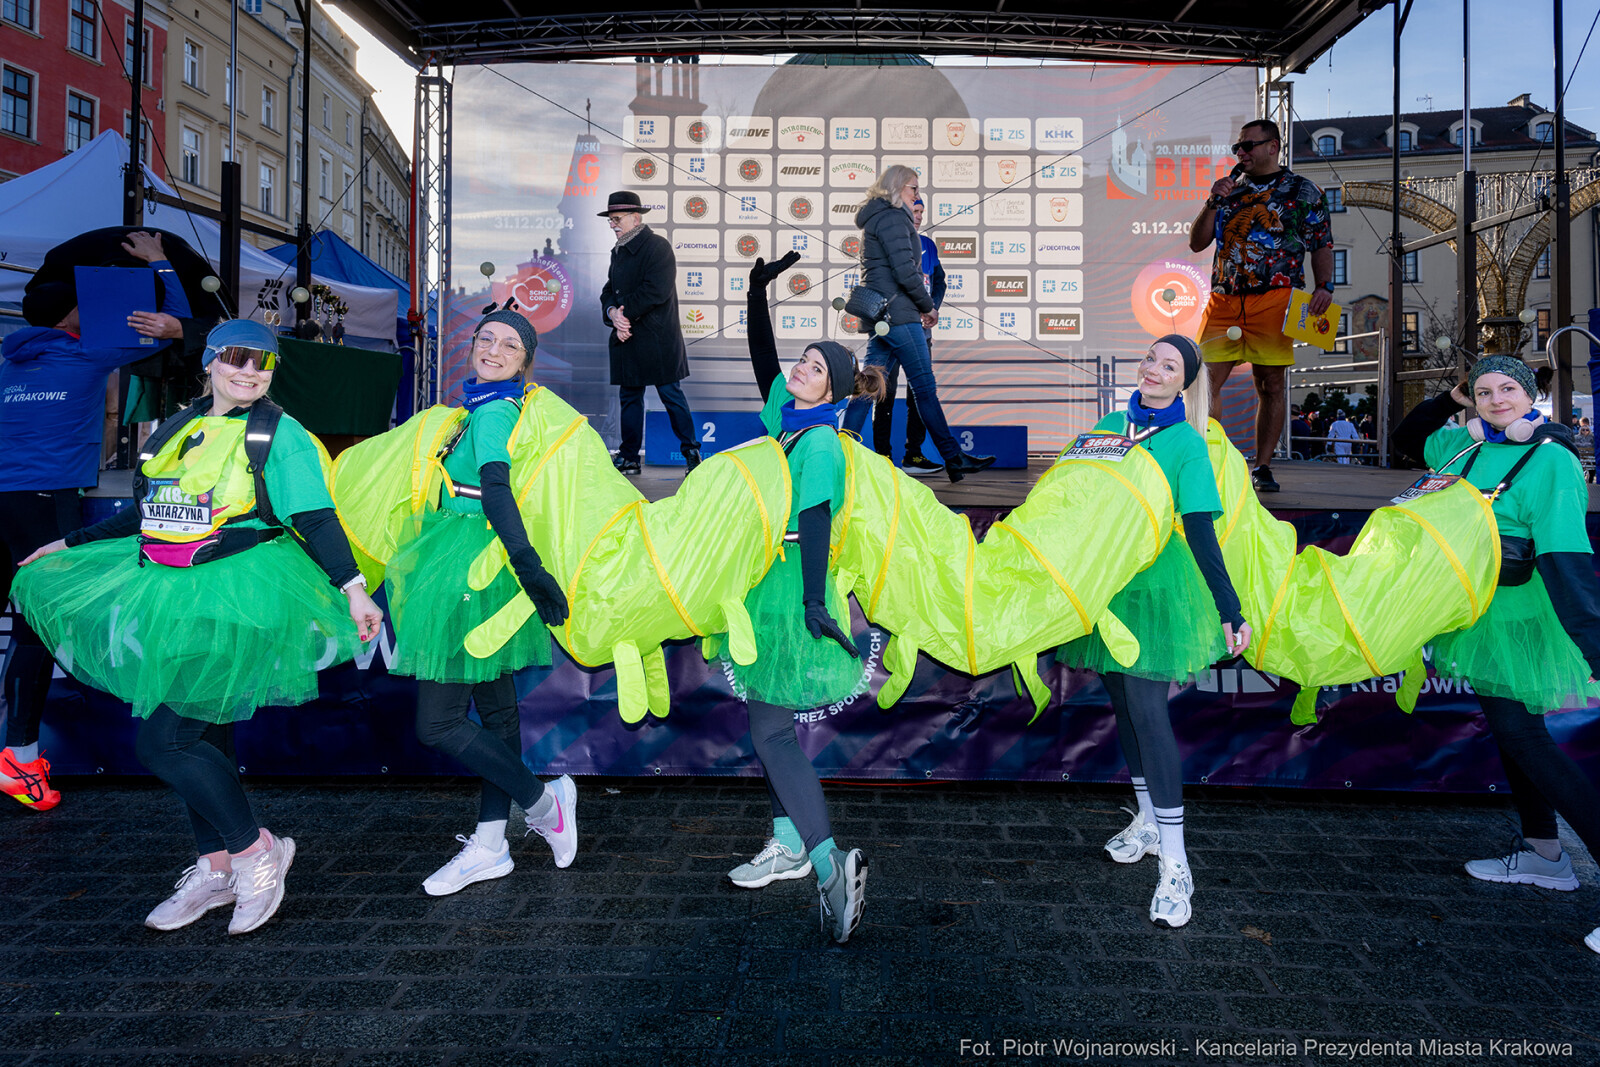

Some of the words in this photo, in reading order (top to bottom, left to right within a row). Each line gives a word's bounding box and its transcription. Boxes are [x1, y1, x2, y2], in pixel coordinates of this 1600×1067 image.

[853, 129, 871, 139] ZIS
[1008, 129, 1025, 139] ZIS
[1045, 130, 1074, 138] KHK
[1155, 145, 1171, 155] 20.
[1060, 167, 1077, 177] ZIS
[832, 204, 858, 213] 4MO
[1131, 222, 1192, 234] 31.12.20
[944, 242, 973, 250] BLACK
[1008, 243, 1026, 253] ZIS
[995, 281, 1024, 289] BLACK
[1060, 281, 1078, 291] ZIS
[800, 317, 817, 328] ZIS
[956, 318, 973, 328] ZIS
[1048, 318, 1076, 327] BLACK
[12, 391, 68, 402] KRAKOWIE
[702, 422, 716, 442] 2
[960, 430, 974, 451] 3
[1085, 437, 1122, 448] 3660
[147, 504, 204, 522] KATARZYNA
